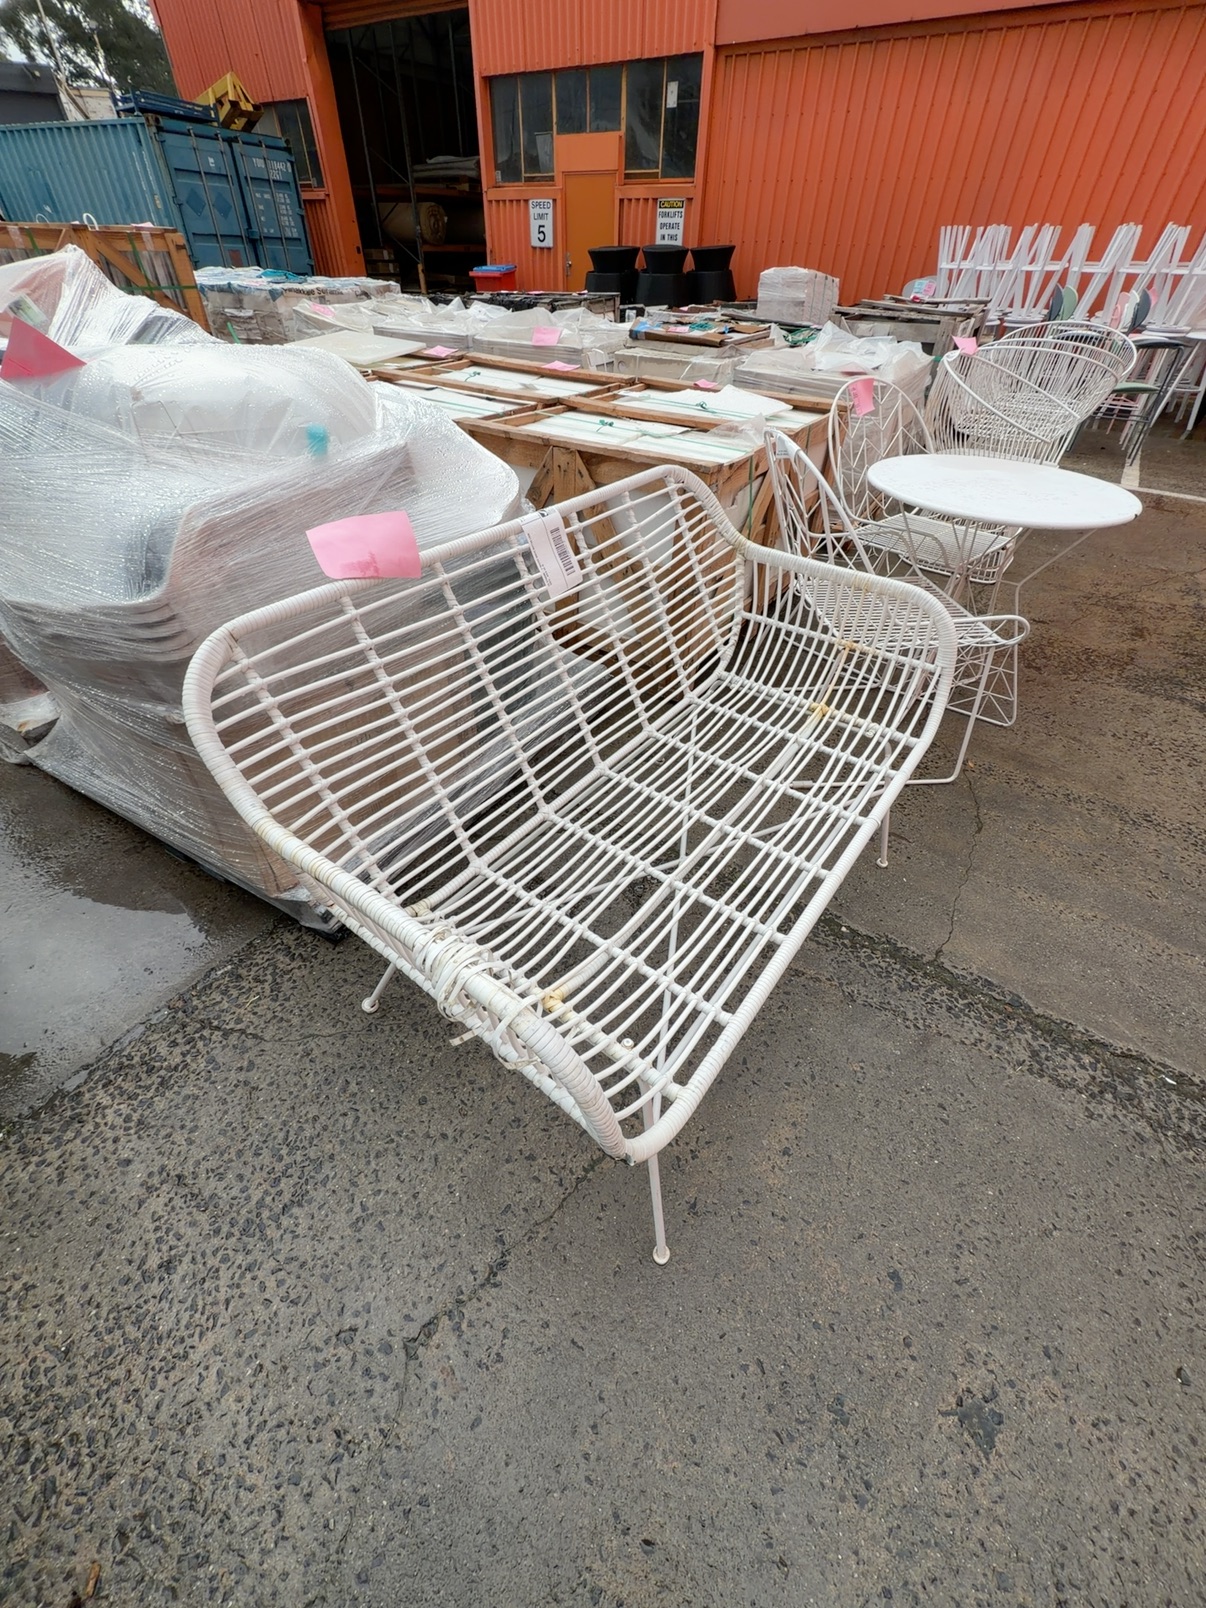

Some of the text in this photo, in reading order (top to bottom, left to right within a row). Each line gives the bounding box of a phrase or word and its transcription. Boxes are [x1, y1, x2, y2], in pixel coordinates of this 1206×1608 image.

[531, 201, 551, 209] SPEED
[659, 222, 680, 230] OPERATE
[537, 224, 546, 243] 5
[660, 233, 678, 242] IN THIS
